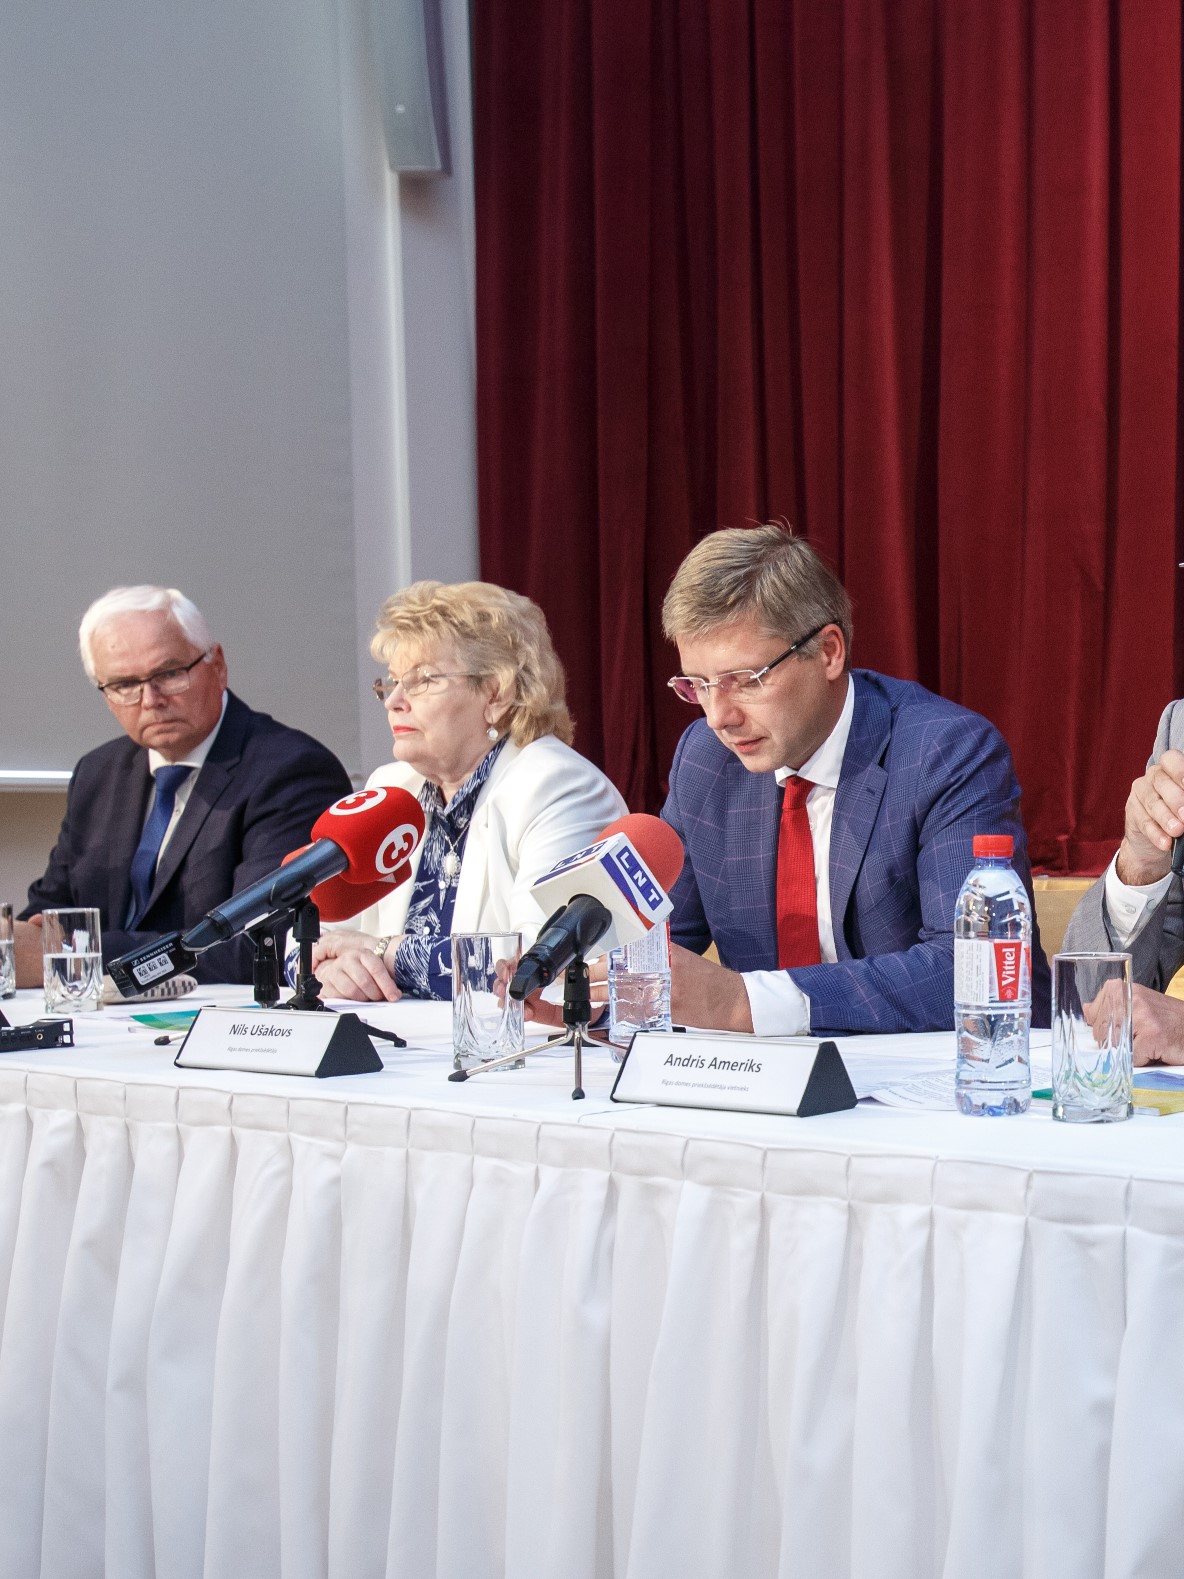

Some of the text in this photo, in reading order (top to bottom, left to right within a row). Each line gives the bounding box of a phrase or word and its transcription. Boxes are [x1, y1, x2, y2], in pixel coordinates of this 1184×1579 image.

[336, 790, 379, 810] 3
[383, 832, 414, 869] 3
[620, 851, 660, 903] LNT
[139, 942, 174, 962] SENNHEISER
[1001, 947, 1016, 987] Vittel
[229, 1023, 293, 1038] Nils Ušakovs
[663, 1053, 763, 1073] Andris Ameriks
